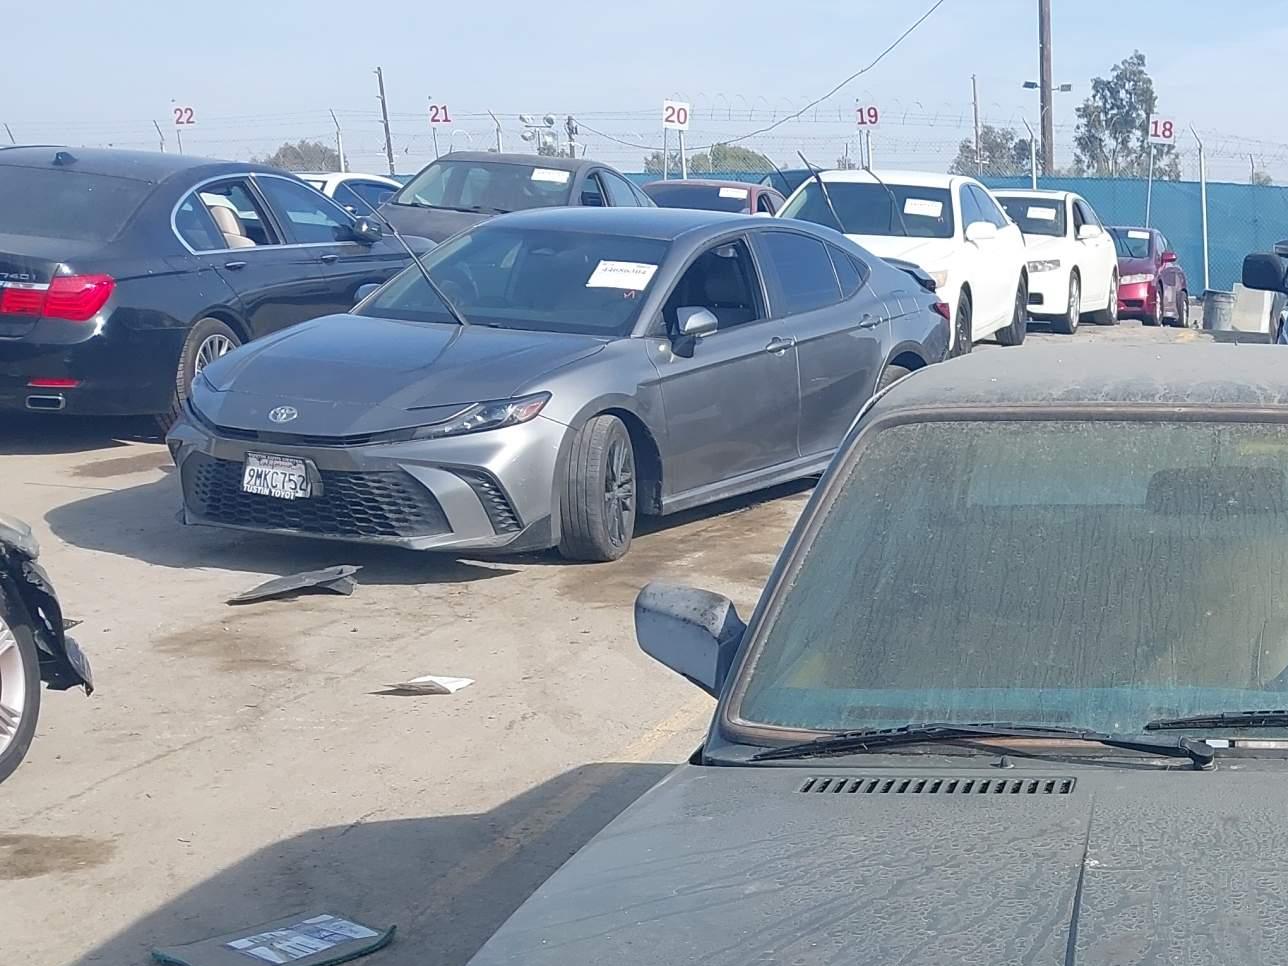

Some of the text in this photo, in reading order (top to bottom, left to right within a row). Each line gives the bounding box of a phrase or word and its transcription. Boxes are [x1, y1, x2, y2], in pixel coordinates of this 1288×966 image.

[174, 107, 195, 125] 22
[429, 105, 452, 123] 21
[664, 105, 688, 124] 20
[856, 106, 879, 125] 19
[1150, 119, 1173, 138] 18
[246, 468, 307, 492] 9MKC752
[243, 485, 270, 496] TUSTIN
